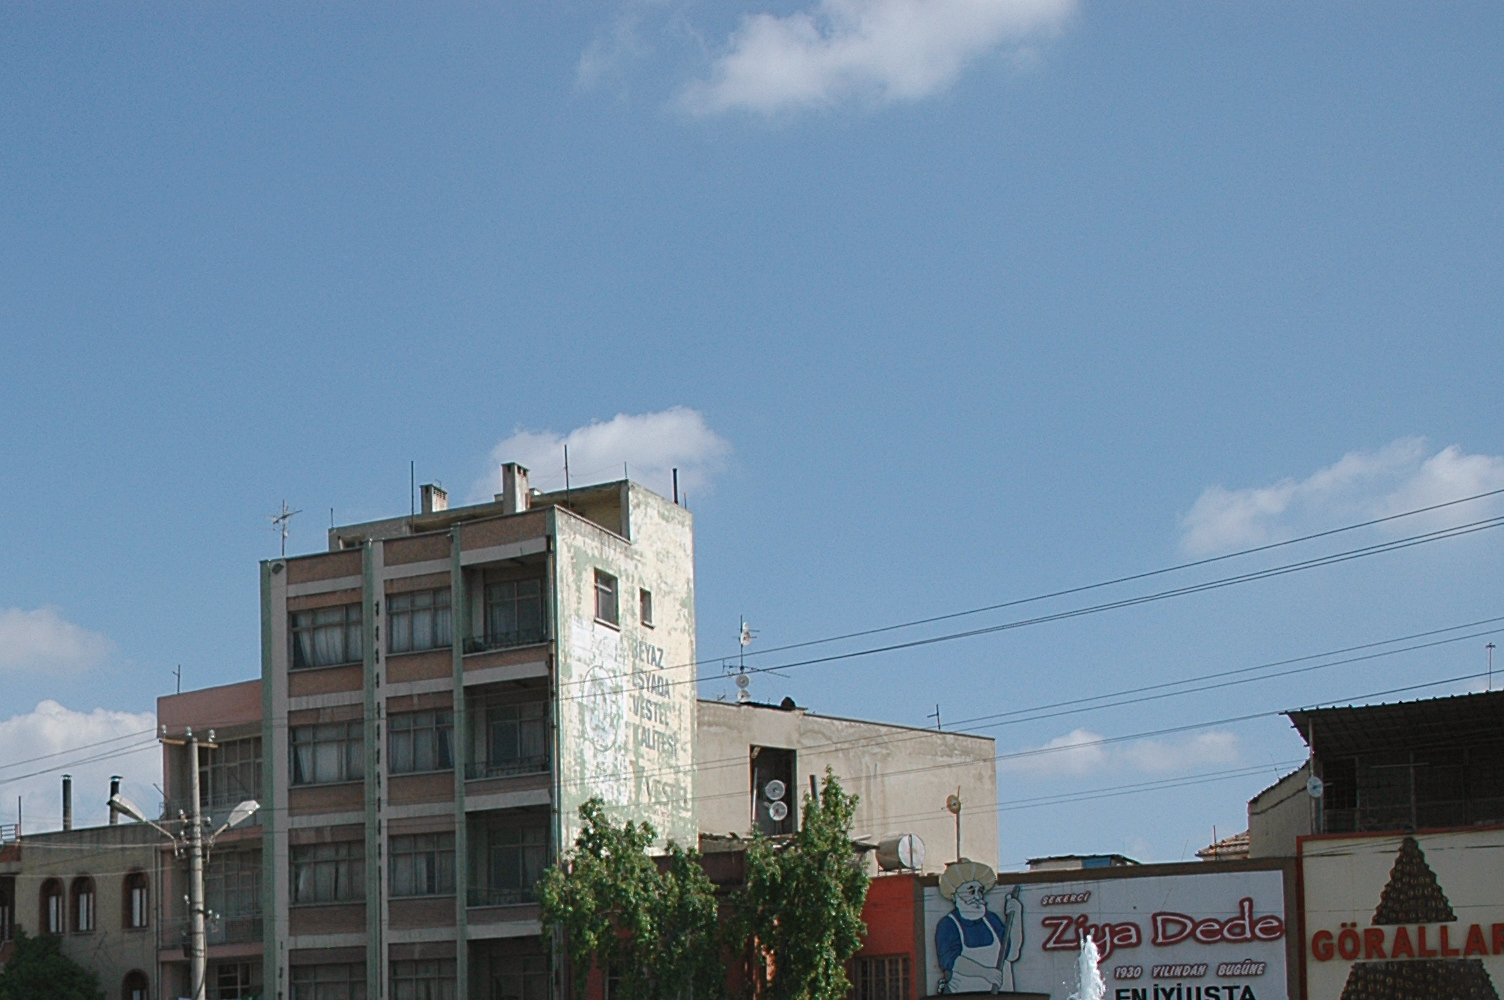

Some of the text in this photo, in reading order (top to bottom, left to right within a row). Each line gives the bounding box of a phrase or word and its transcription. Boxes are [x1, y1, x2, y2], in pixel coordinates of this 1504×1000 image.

[1041, 897, 1286, 964] Ziya Dede
[1114, 965, 1143, 979] 1930
